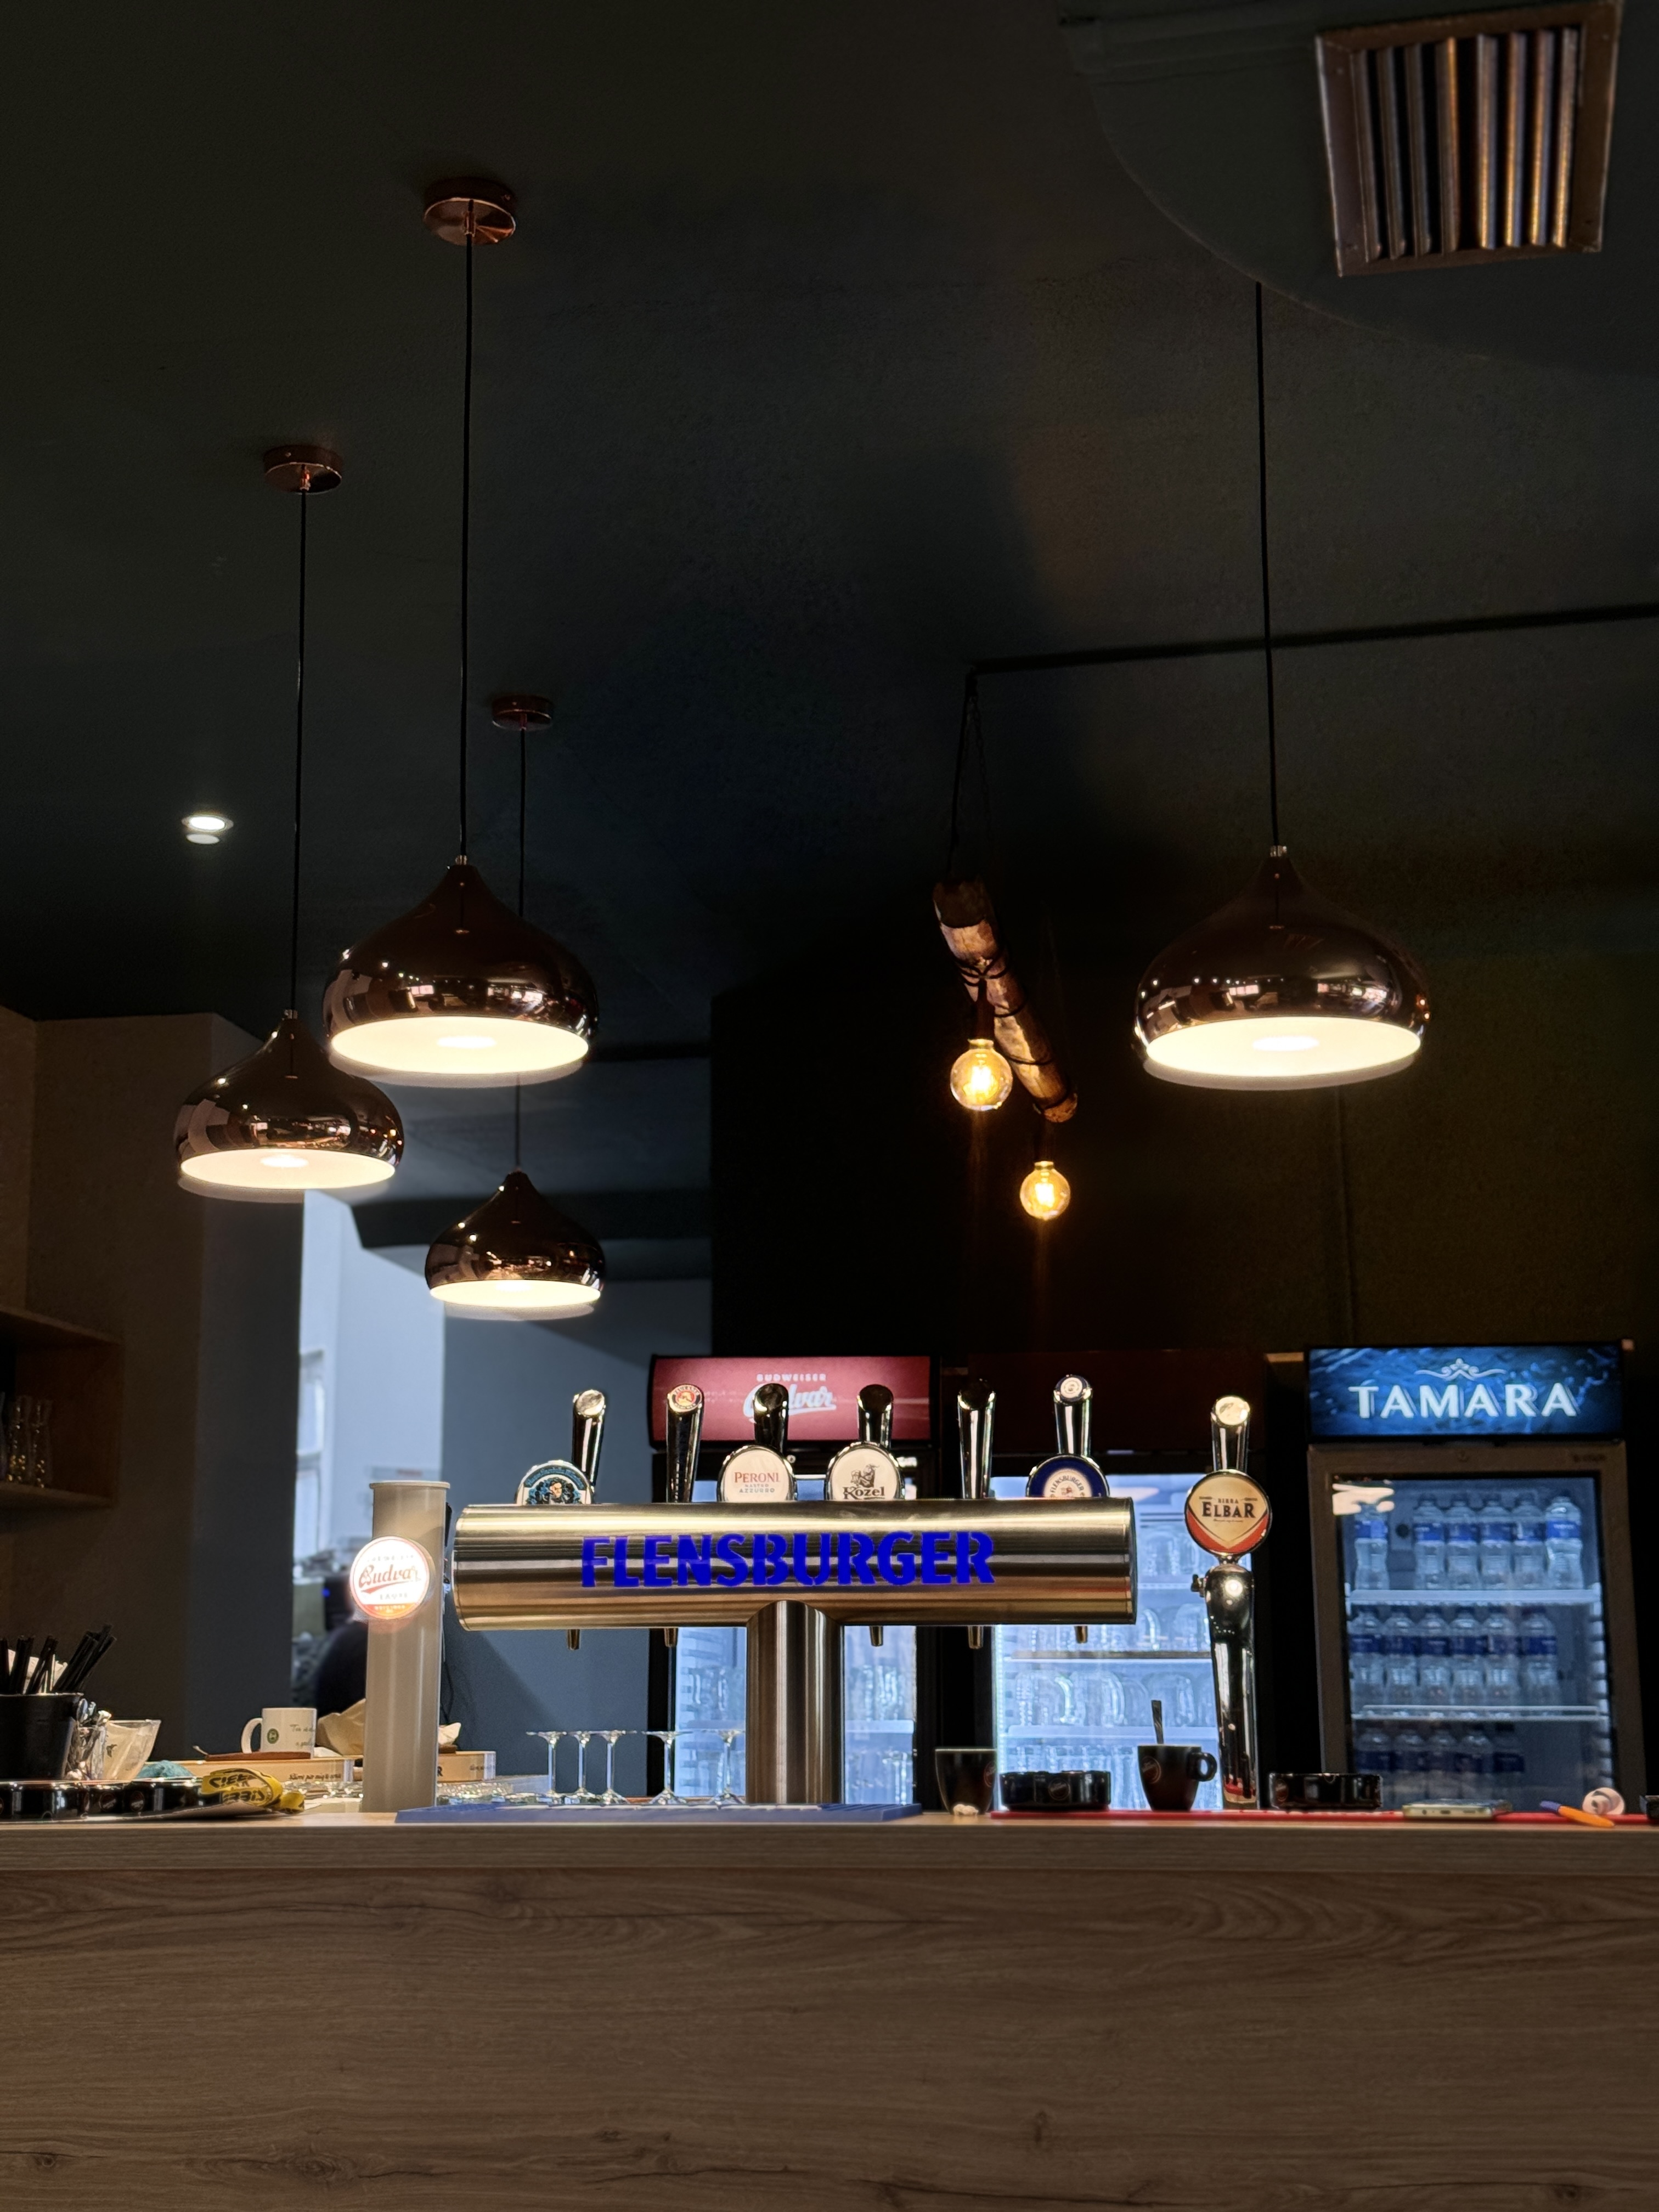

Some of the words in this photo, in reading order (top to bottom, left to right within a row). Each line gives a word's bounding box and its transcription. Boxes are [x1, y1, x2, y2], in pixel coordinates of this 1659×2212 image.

[756, 1373, 826, 1382] BUDWEISER
[1348, 1382, 1579, 1419] TAMARA
[734, 1472, 780, 1483] PERONI
[1050, 1475, 1085, 1493] FLENSBURGER
[842, 1486, 885, 1500] Kozel
[1201, 1501, 1256, 1519] ELBAR
[582, 1531, 995, 1587] FLENSBURGER
[358, 1564, 421, 1588] Budvar
